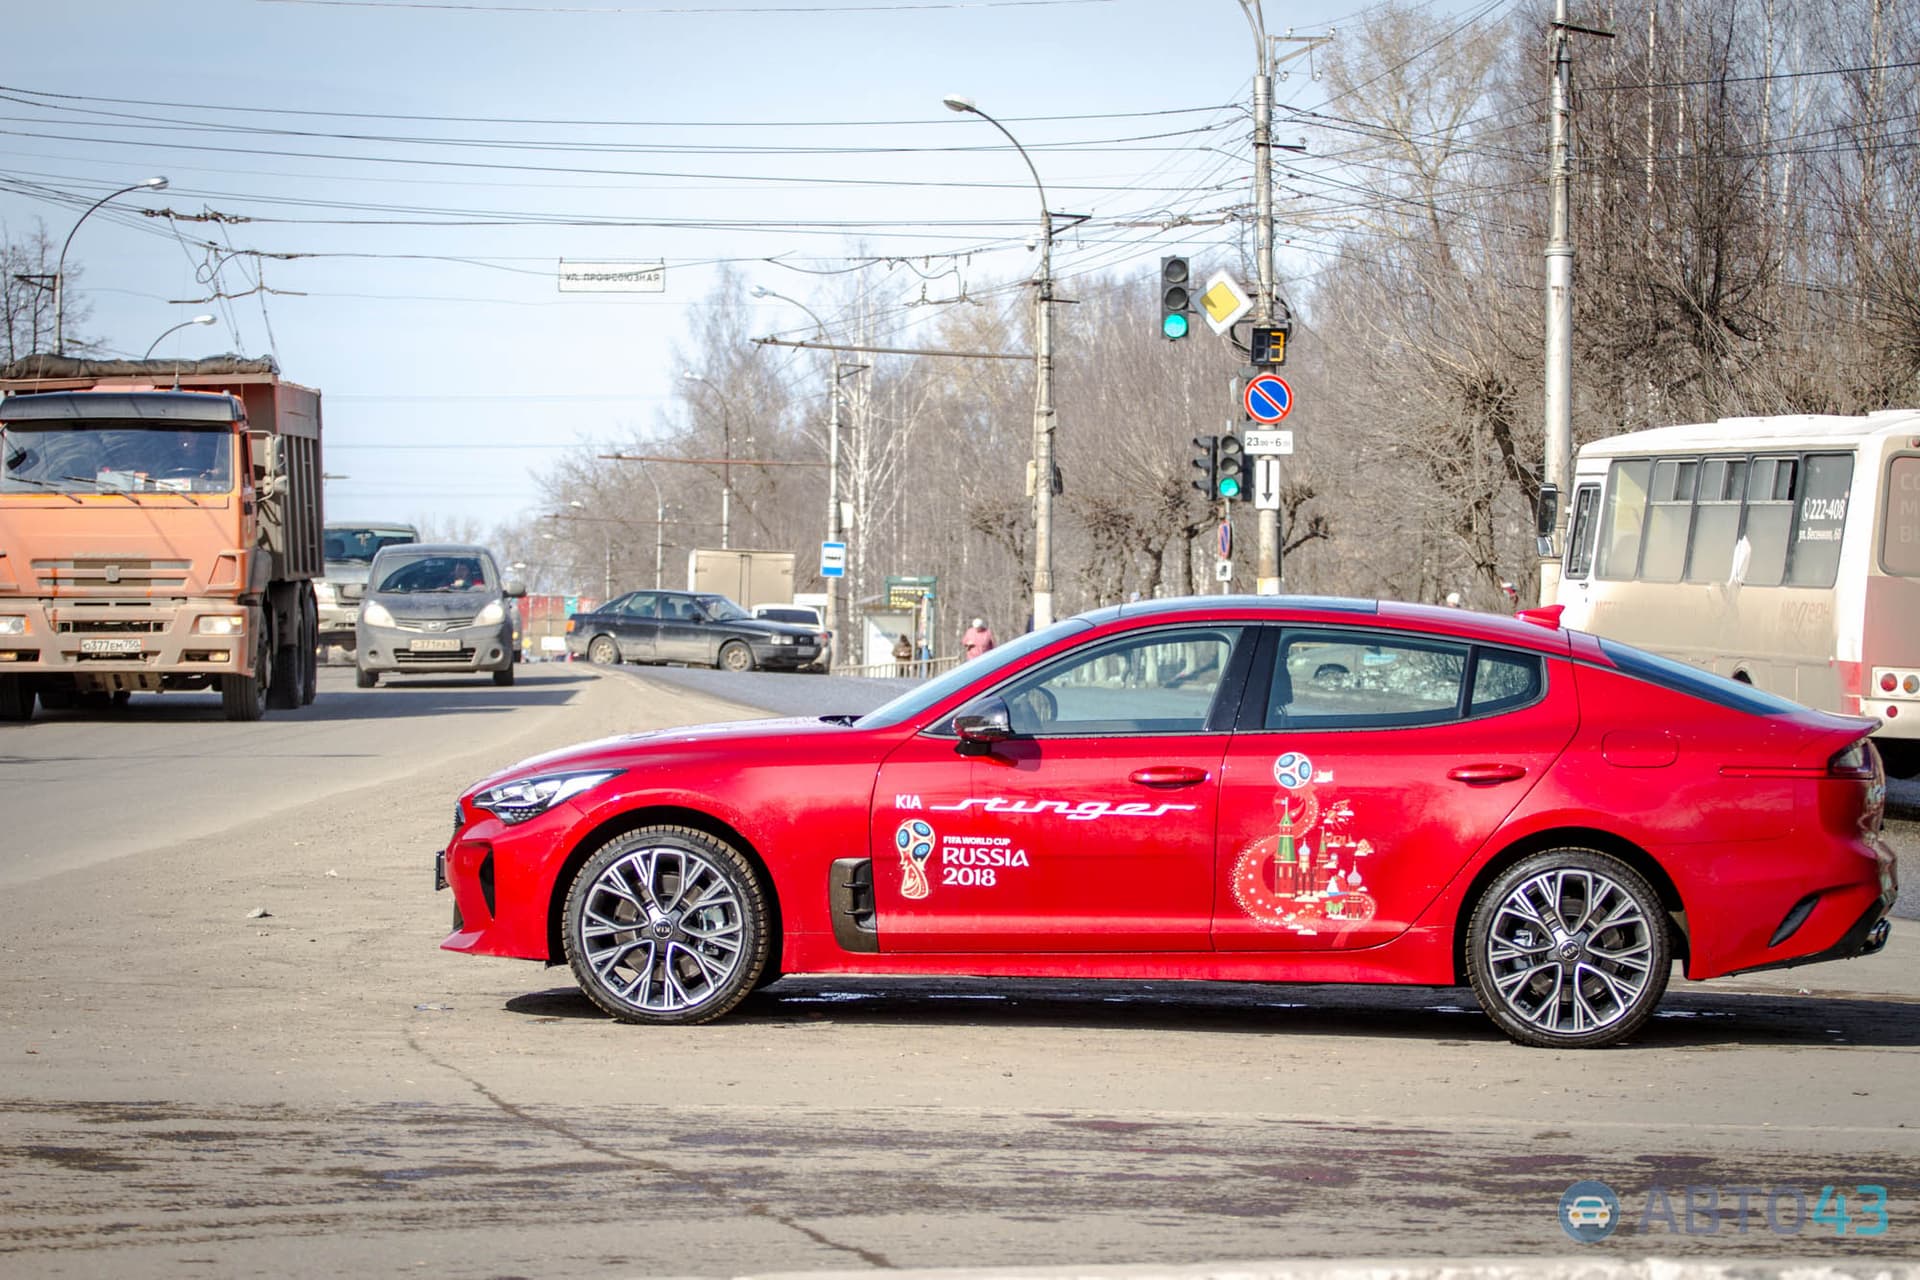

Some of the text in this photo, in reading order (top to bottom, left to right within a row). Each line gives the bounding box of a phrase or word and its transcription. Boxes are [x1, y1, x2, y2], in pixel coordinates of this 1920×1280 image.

[1269, 331, 1284, 361] 3
[1809, 498, 1846, 521] 222-408
[896, 794, 922, 810] KIA
[943, 835, 1011, 847] FIFA WORLD CUP
[943, 847, 1030, 868] RUSSIA
[942, 867, 996, 886] 2018
[1562, 946, 1578, 957] KIA
